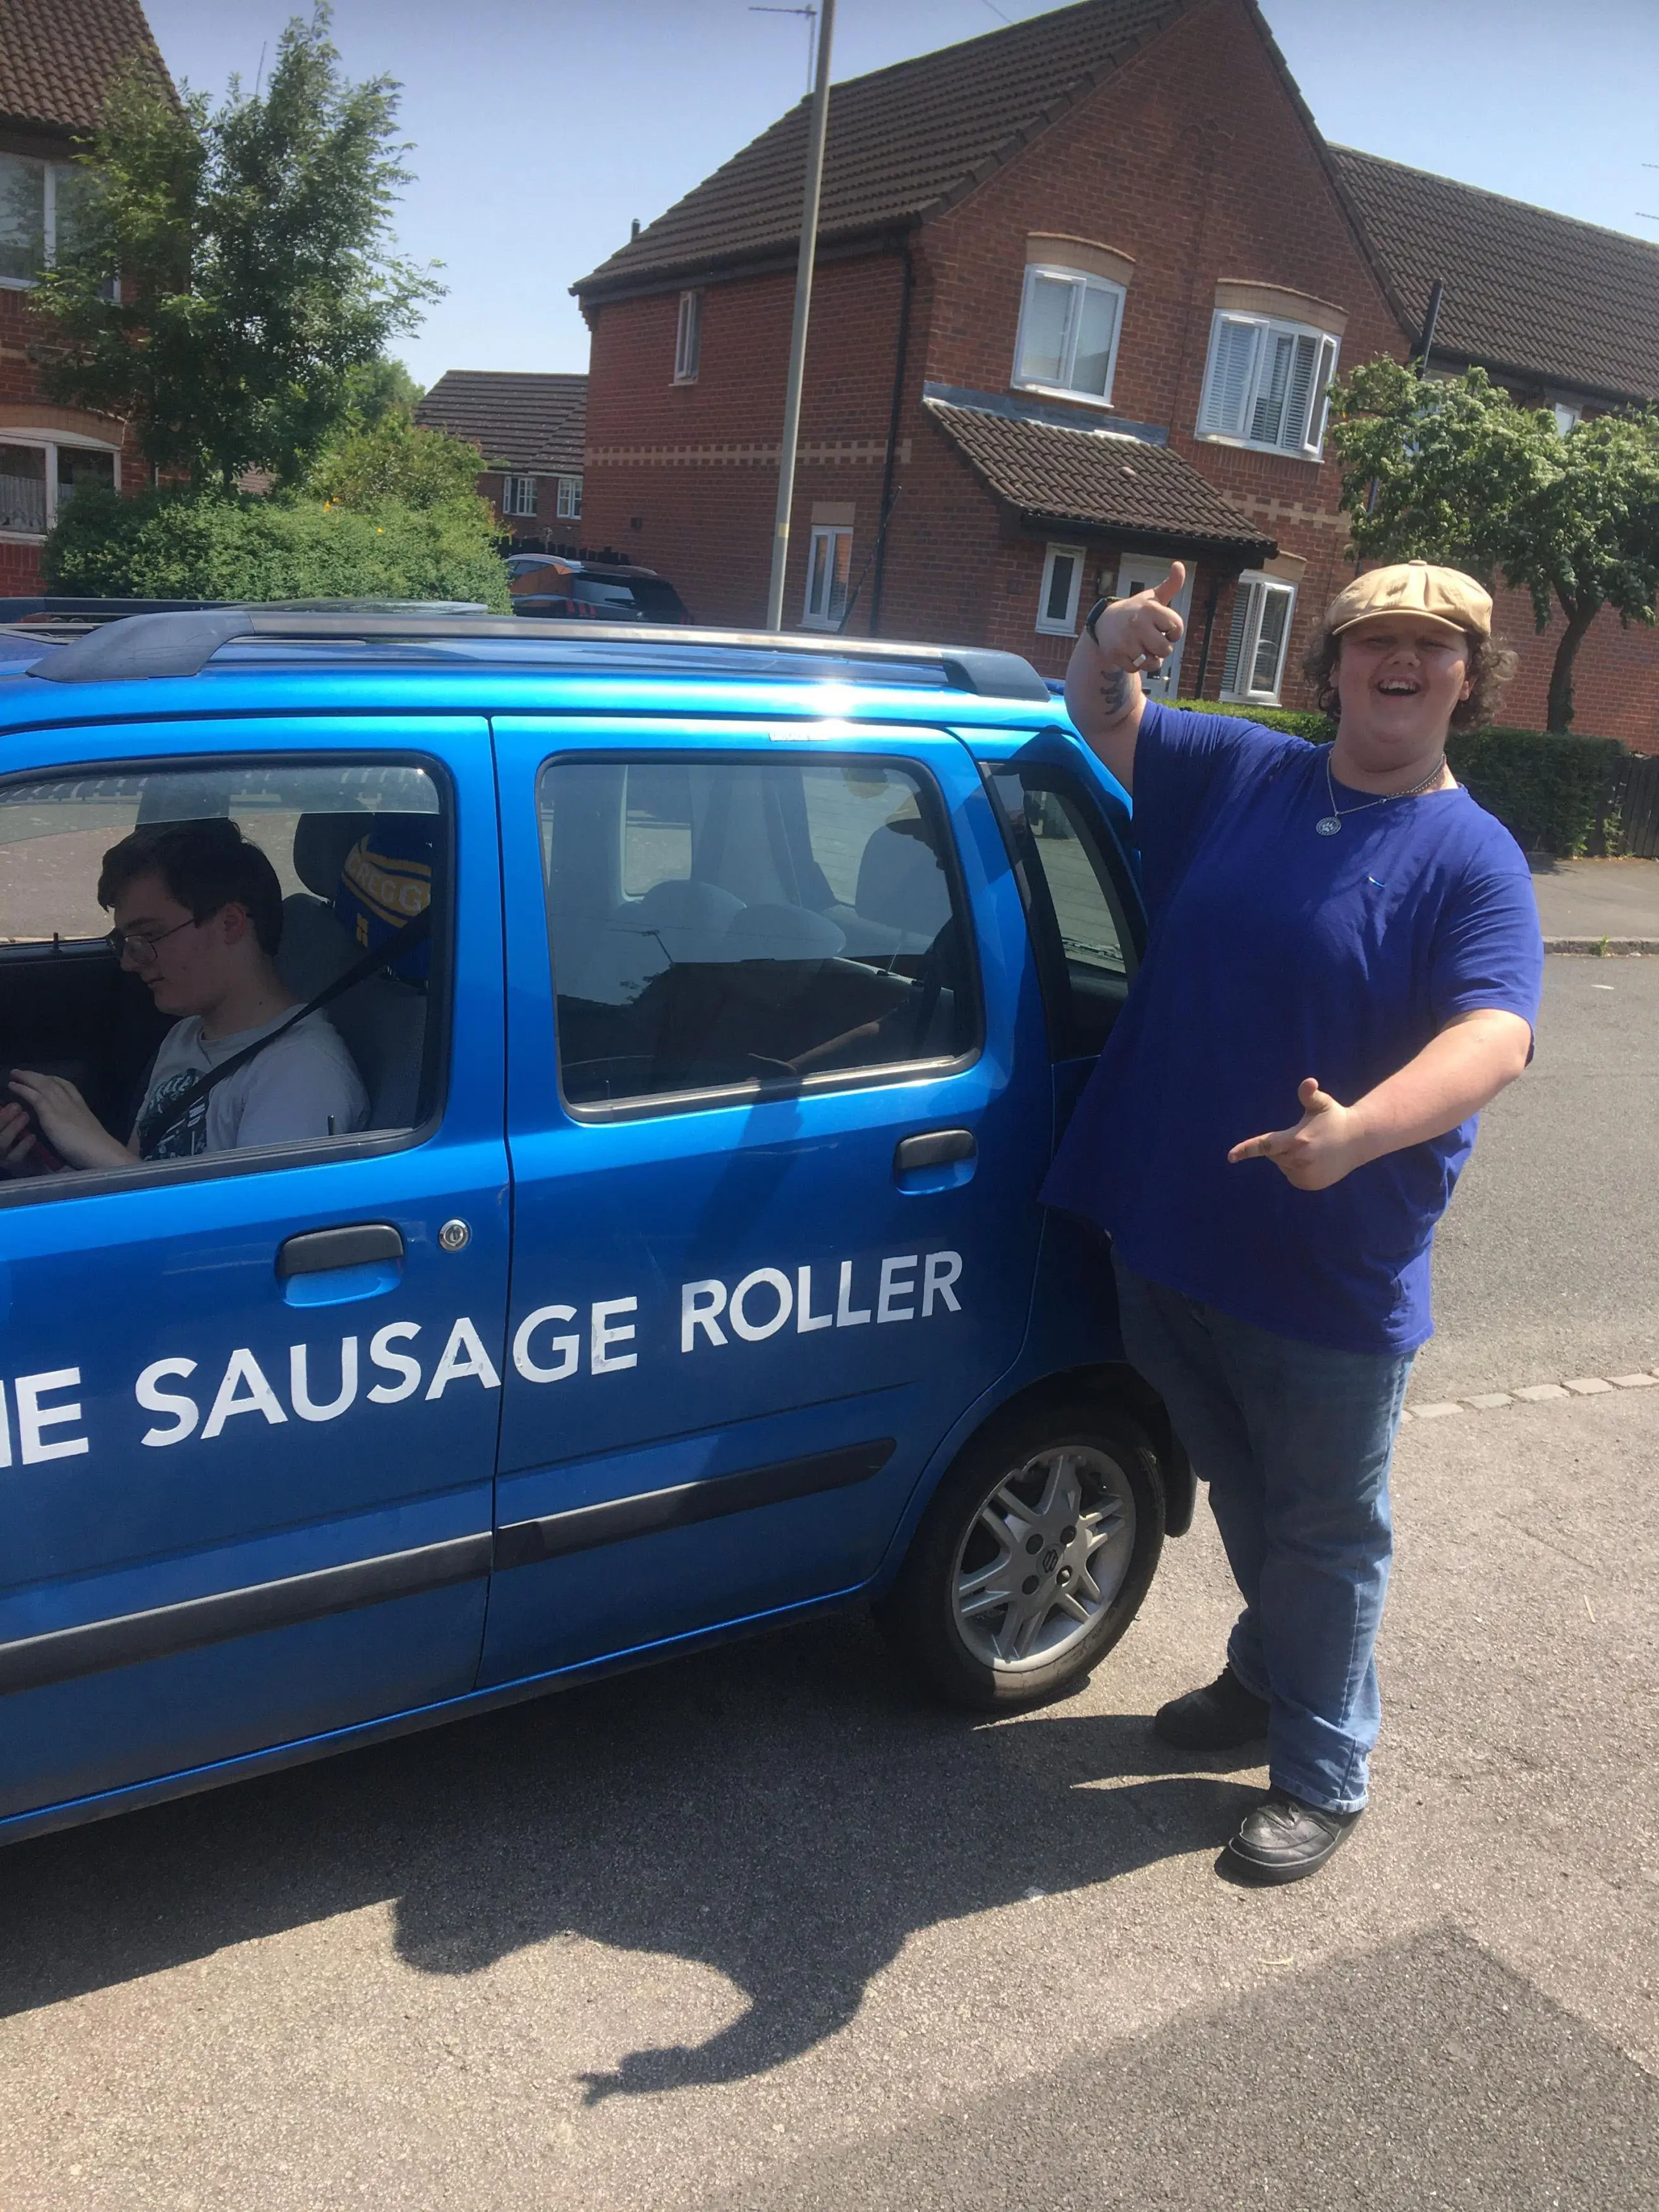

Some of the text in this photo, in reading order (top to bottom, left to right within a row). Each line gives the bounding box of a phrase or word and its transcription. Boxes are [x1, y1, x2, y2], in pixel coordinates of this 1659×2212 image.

[348, 854, 431, 912] GREGG
[0, 1251, 963, 1468] E SAUSAGE ROLLER
